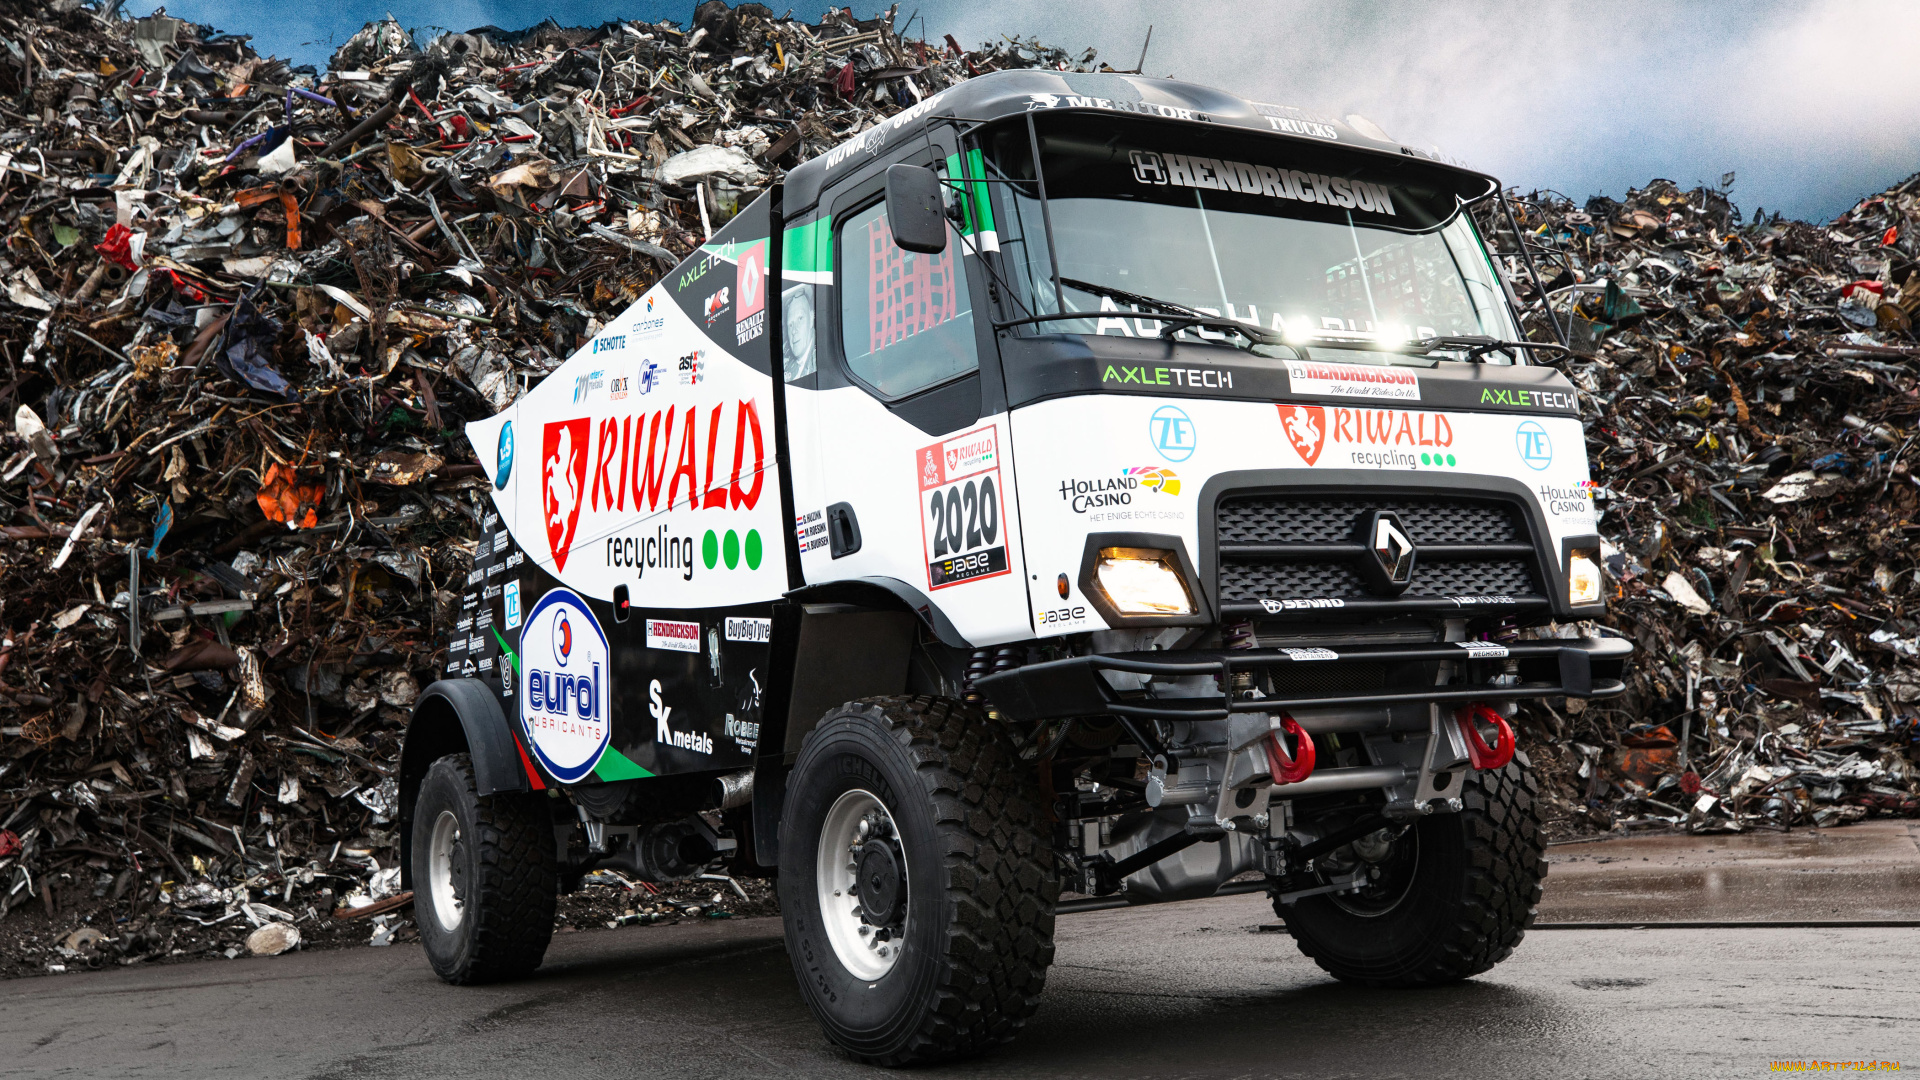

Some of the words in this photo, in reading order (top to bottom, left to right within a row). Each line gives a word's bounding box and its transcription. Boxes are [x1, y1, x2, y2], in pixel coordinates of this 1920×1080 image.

[1065, 96, 1193, 120] MERITOR
[825, 135, 866, 170] NIJWA
[893, 94, 945, 129] GROEP
[1264, 116, 1338, 140] TRUCKS
[1162, 152, 1396, 216] HENDRICKSON
[678, 237, 735, 292] AXLETECH
[633, 317, 664, 332] carbones
[736, 309, 765, 336] RENAULT
[599, 335, 626, 351] SCHOTTE
[737, 323, 763, 346] TRUCKS
[610, 377, 628, 393] ORYX
[1102, 365, 1233, 389] AXLETECH
[1303, 364, 1416, 385] HENDRICKSON
[1330, 385, 1344, 394] The
[1346, 386, 1369, 396] World
[1372, 387, 1394, 397] Rides
[1395, 389, 1404, 397] On
[1405, 389, 1416, 398] Us
[1480, 388, 1576, 409] AXLETECH
[1152, 416, 1194, 450] ZF
[1333, 407, 1454, 448] RIWALD
[591, 398, 765, 513] RIWALD
[959, 438, 993, 461] RIWALD
[1351, 449, 1417, 470] recycling
[963, 456, 982, 468] recycling
[923, 472, 940, 487] DAKAR
[1059, 477, 1137, 501] HOLLAND
[1072, 492, 1132, 513] CASINO
[1540, 485, 1587, 502] HOLLAND
[931, 475, 998, 559] 2020
[1090, 513, 1104, 522] HET
[1107, 512, 1132, 521] ENIGE
[1134, 511, 1156, 520] ECHTE
[1158, 511, 1184, 520] CASINO
[1550, 500, 1585, 516] CASINO
[606, 524, 694, 581] recycling
[956, 567, 991, 579] RECLAME
[1281, 598, 1345, 609] SENRO
[653, 622, 698, 640] HENDRICKSON
[1048, 620, 1086, 628] RECLAME
[529, 662, 600, 722] eurol
[673, 730, 713, 755] metals
